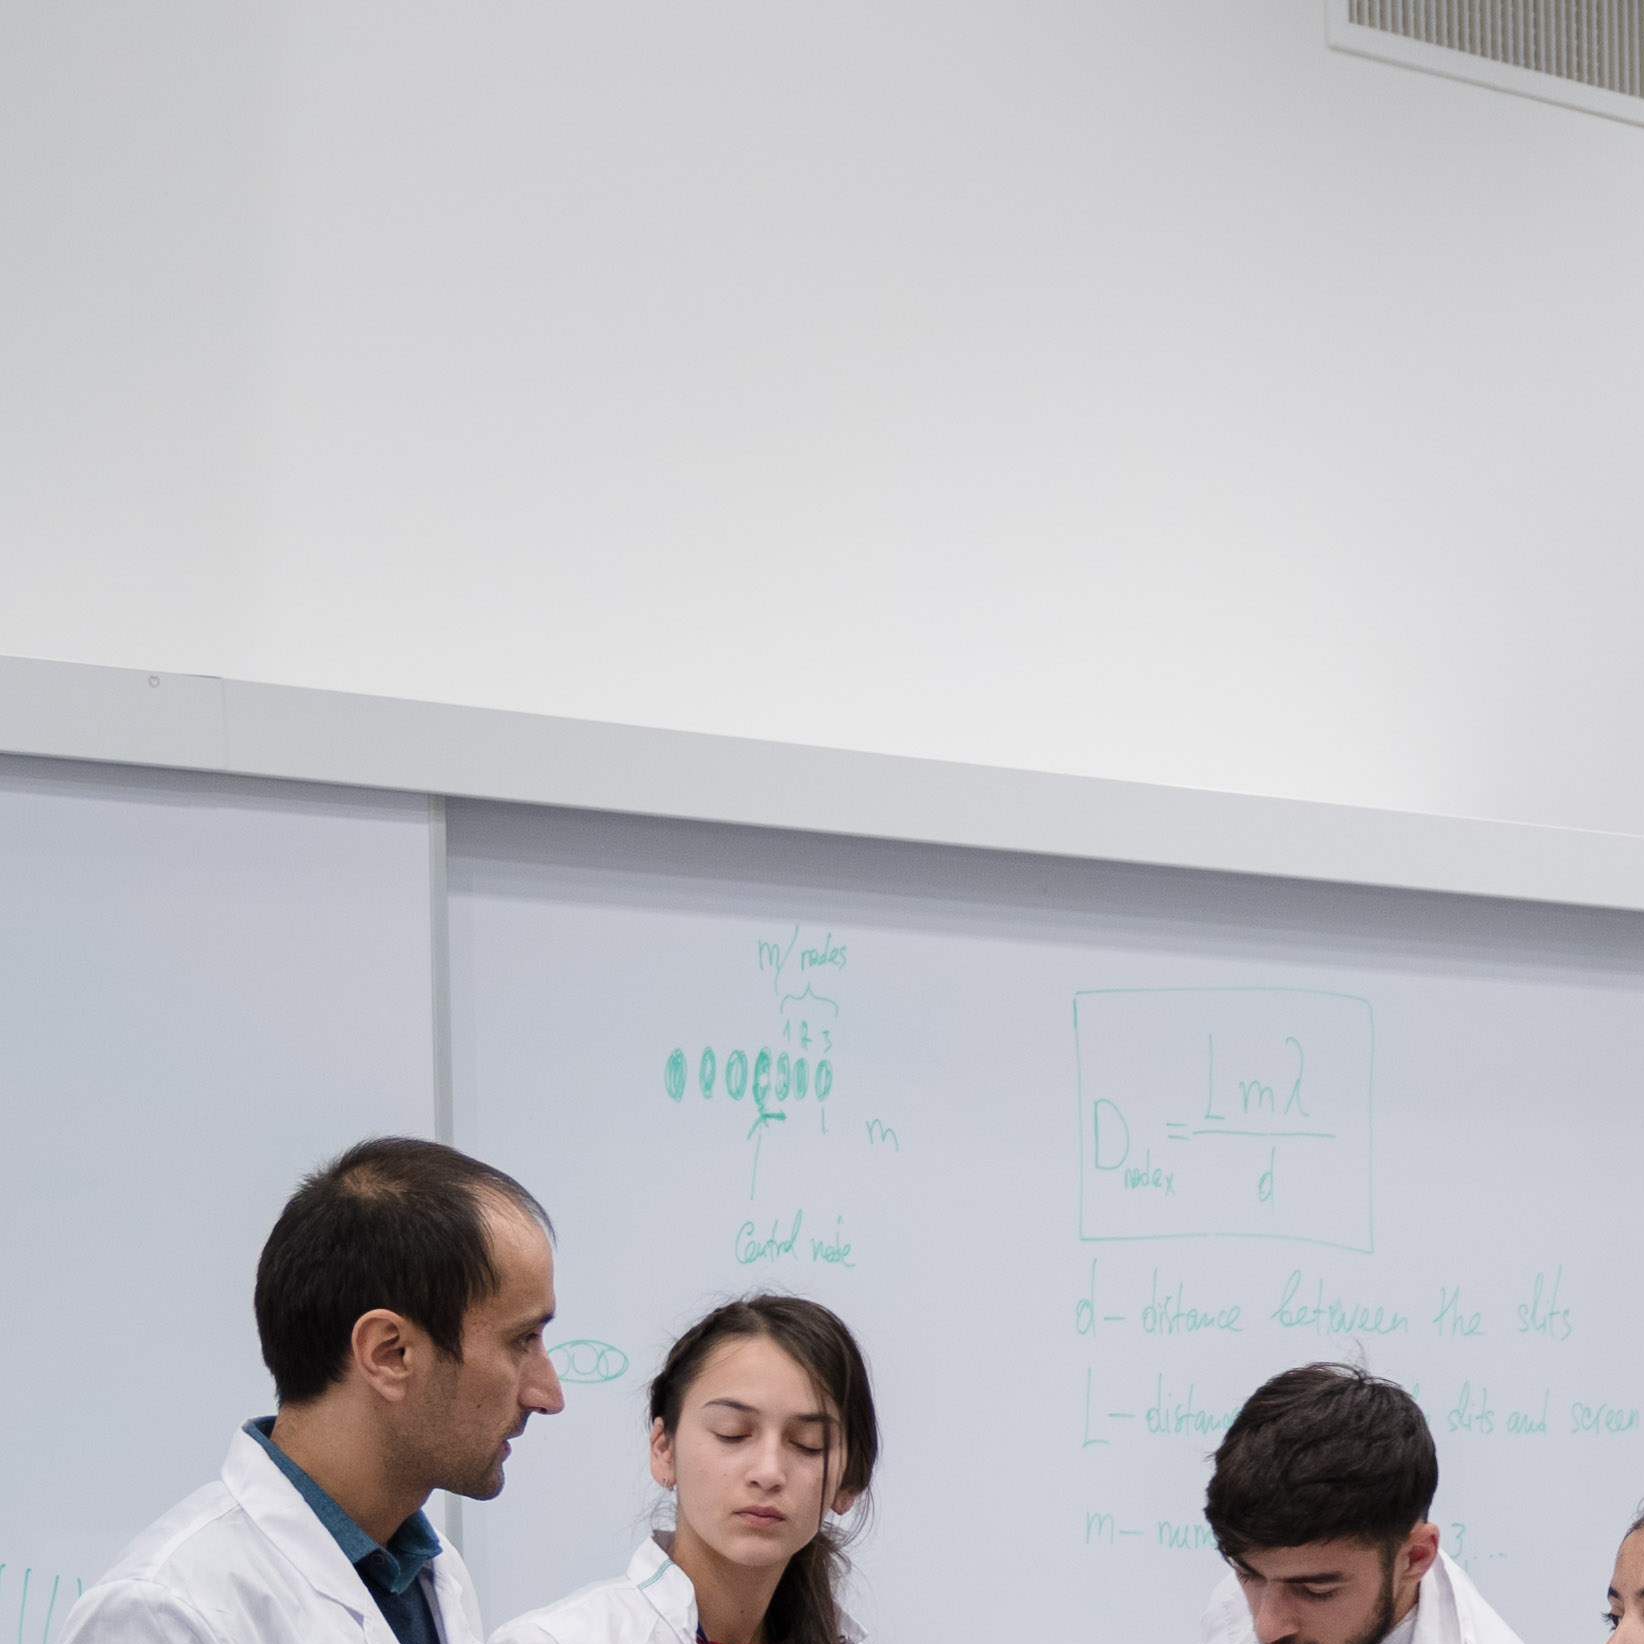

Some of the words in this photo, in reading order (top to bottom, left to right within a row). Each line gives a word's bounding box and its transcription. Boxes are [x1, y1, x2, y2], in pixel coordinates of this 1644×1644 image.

[1142, 1266, 1245, 1336] distance
[1271, 1269, 1410, 1338] between
[1432, 1285, 1487, 1338] the
[1517, 1263, 1575, 1343] slits
[1448, 1380, 1495, 1436] slits
[1506, 1388, 1550, 1435] and
[1570, 1401, 1640, 1436] screen
